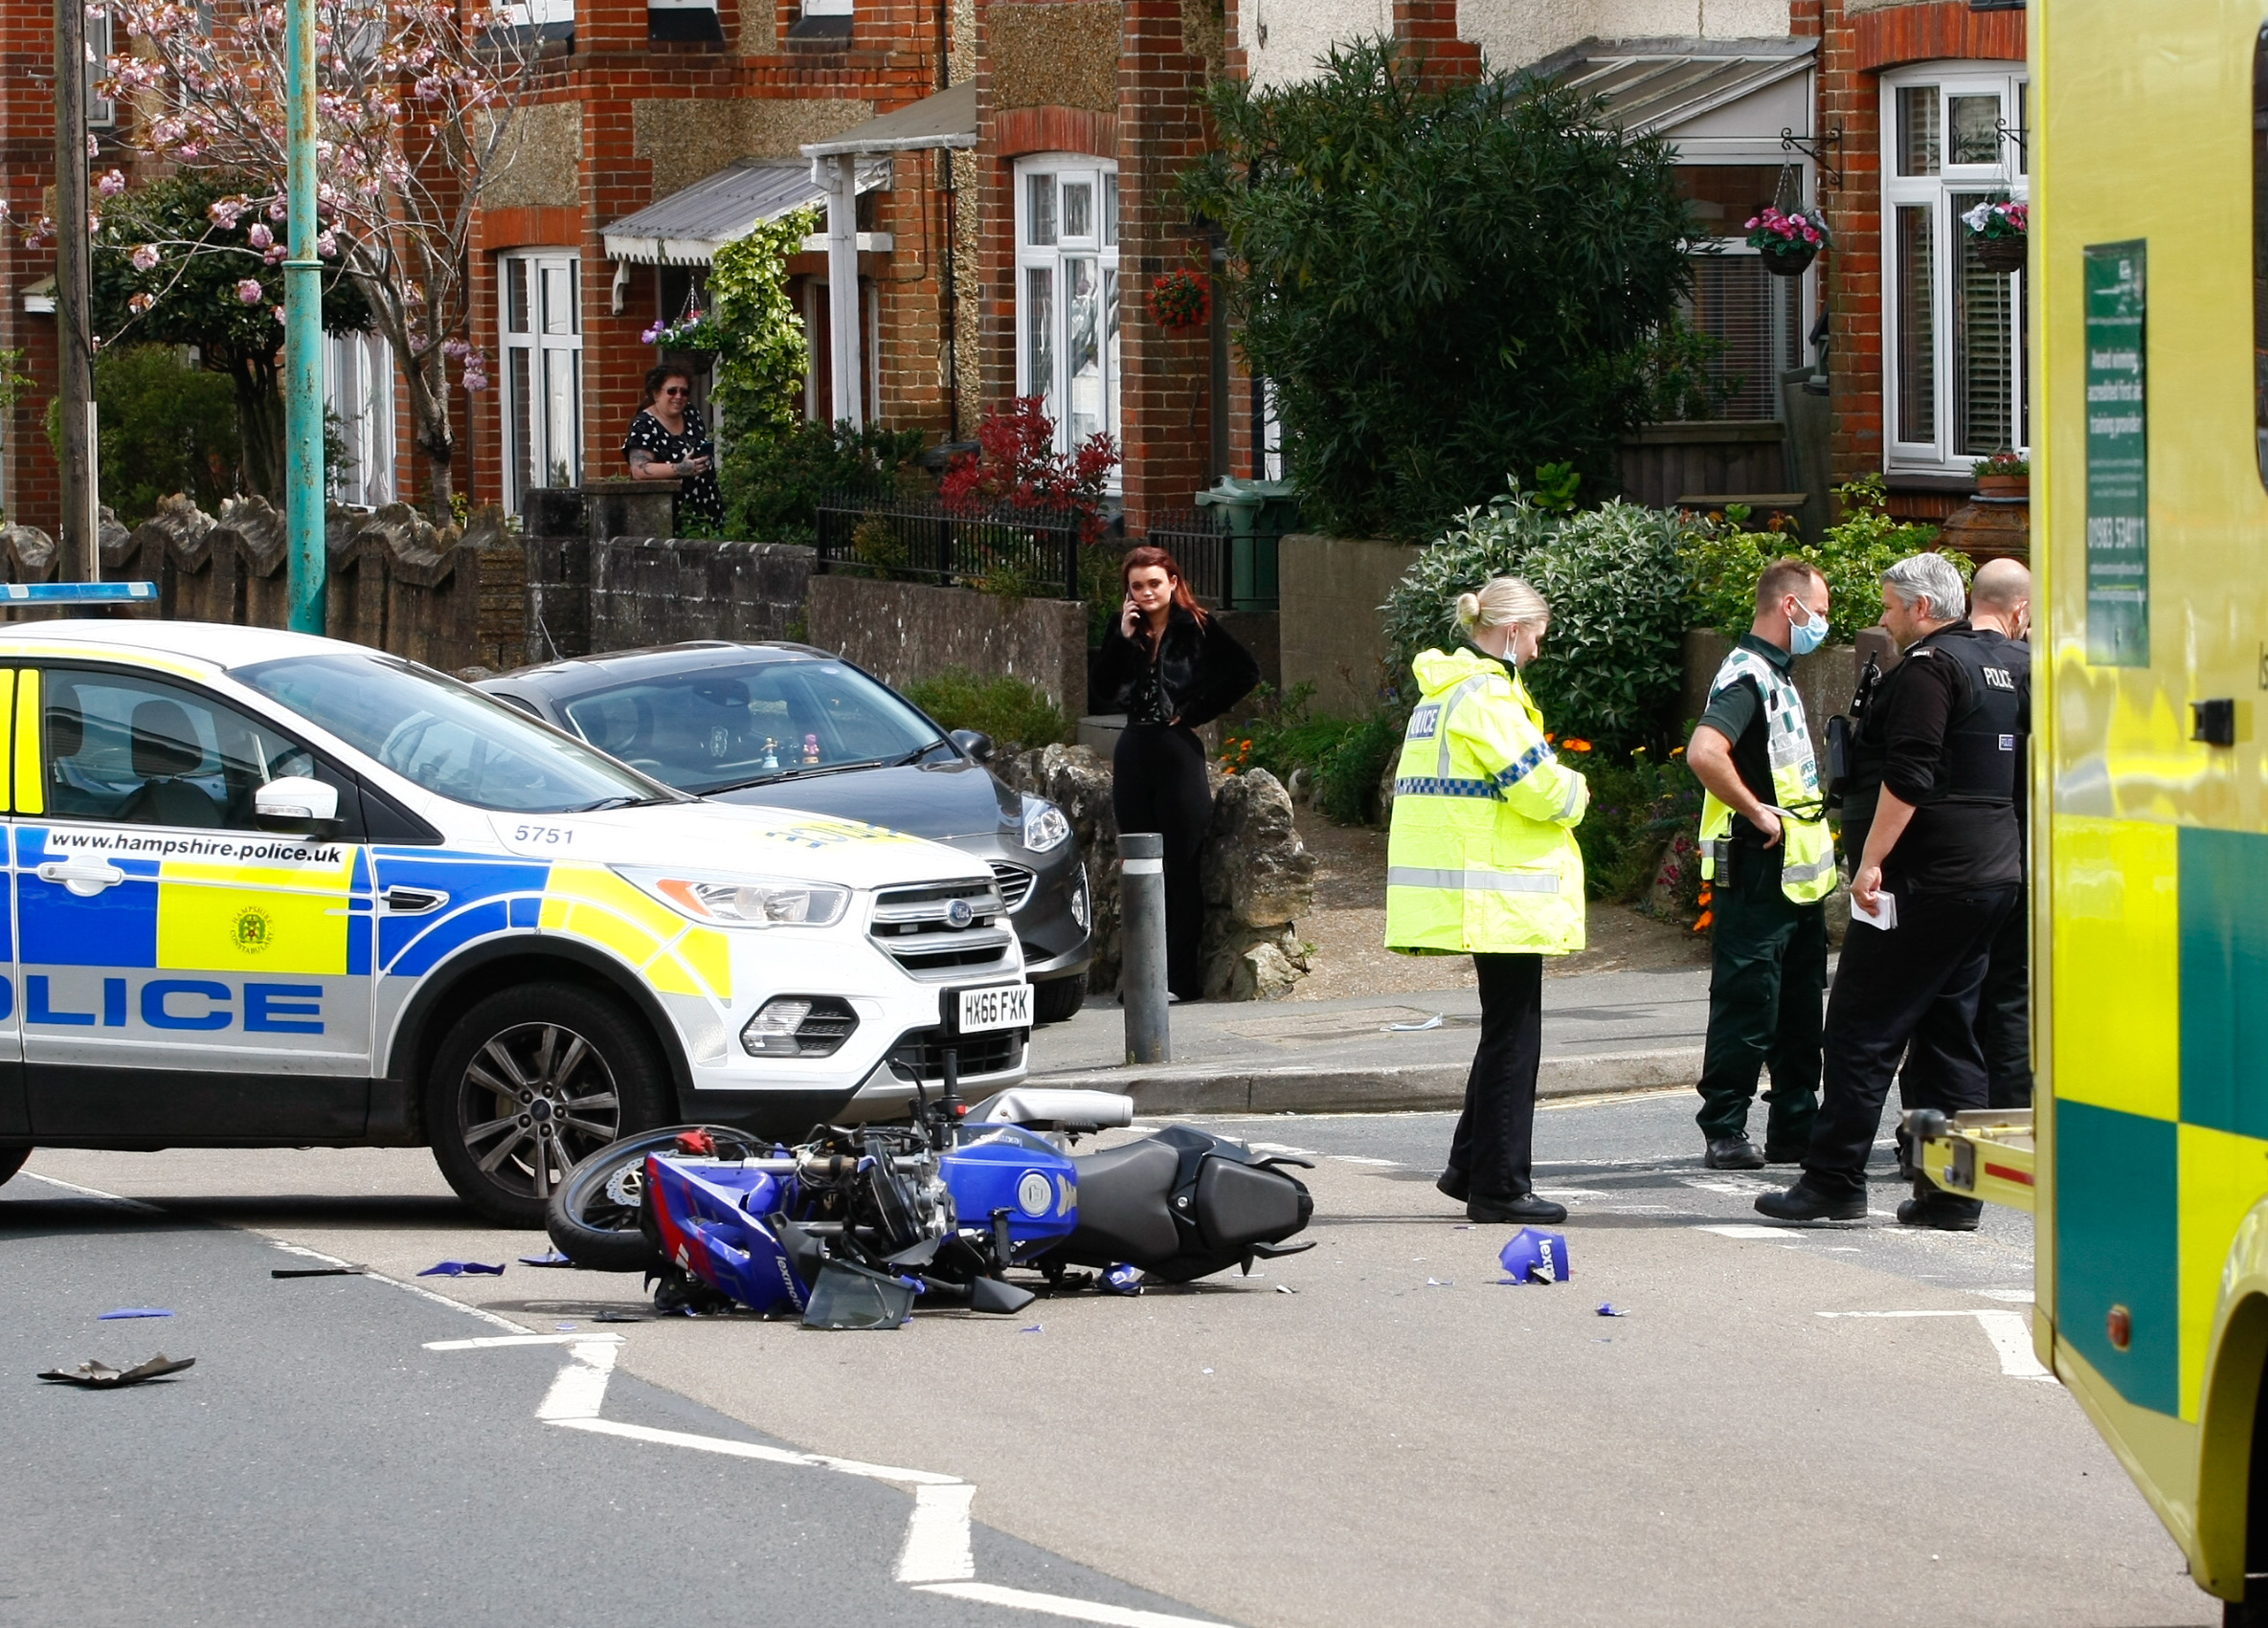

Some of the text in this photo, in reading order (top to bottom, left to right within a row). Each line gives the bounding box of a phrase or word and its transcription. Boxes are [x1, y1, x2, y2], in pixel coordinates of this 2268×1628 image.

[1983, 666, 2014, 689] POLICE
[514, 825, 573, 844] 5751
[52, 834, 342, 863] www.hampshire.police.uk
[231, 905, 274, 926] HAMPSHIRE
[230, 928, 275, 955] CONSTABULARY
[965, 989, 1028, 1026] HX66 FXK
[775, 1255, 803, 1311] lexmoto
